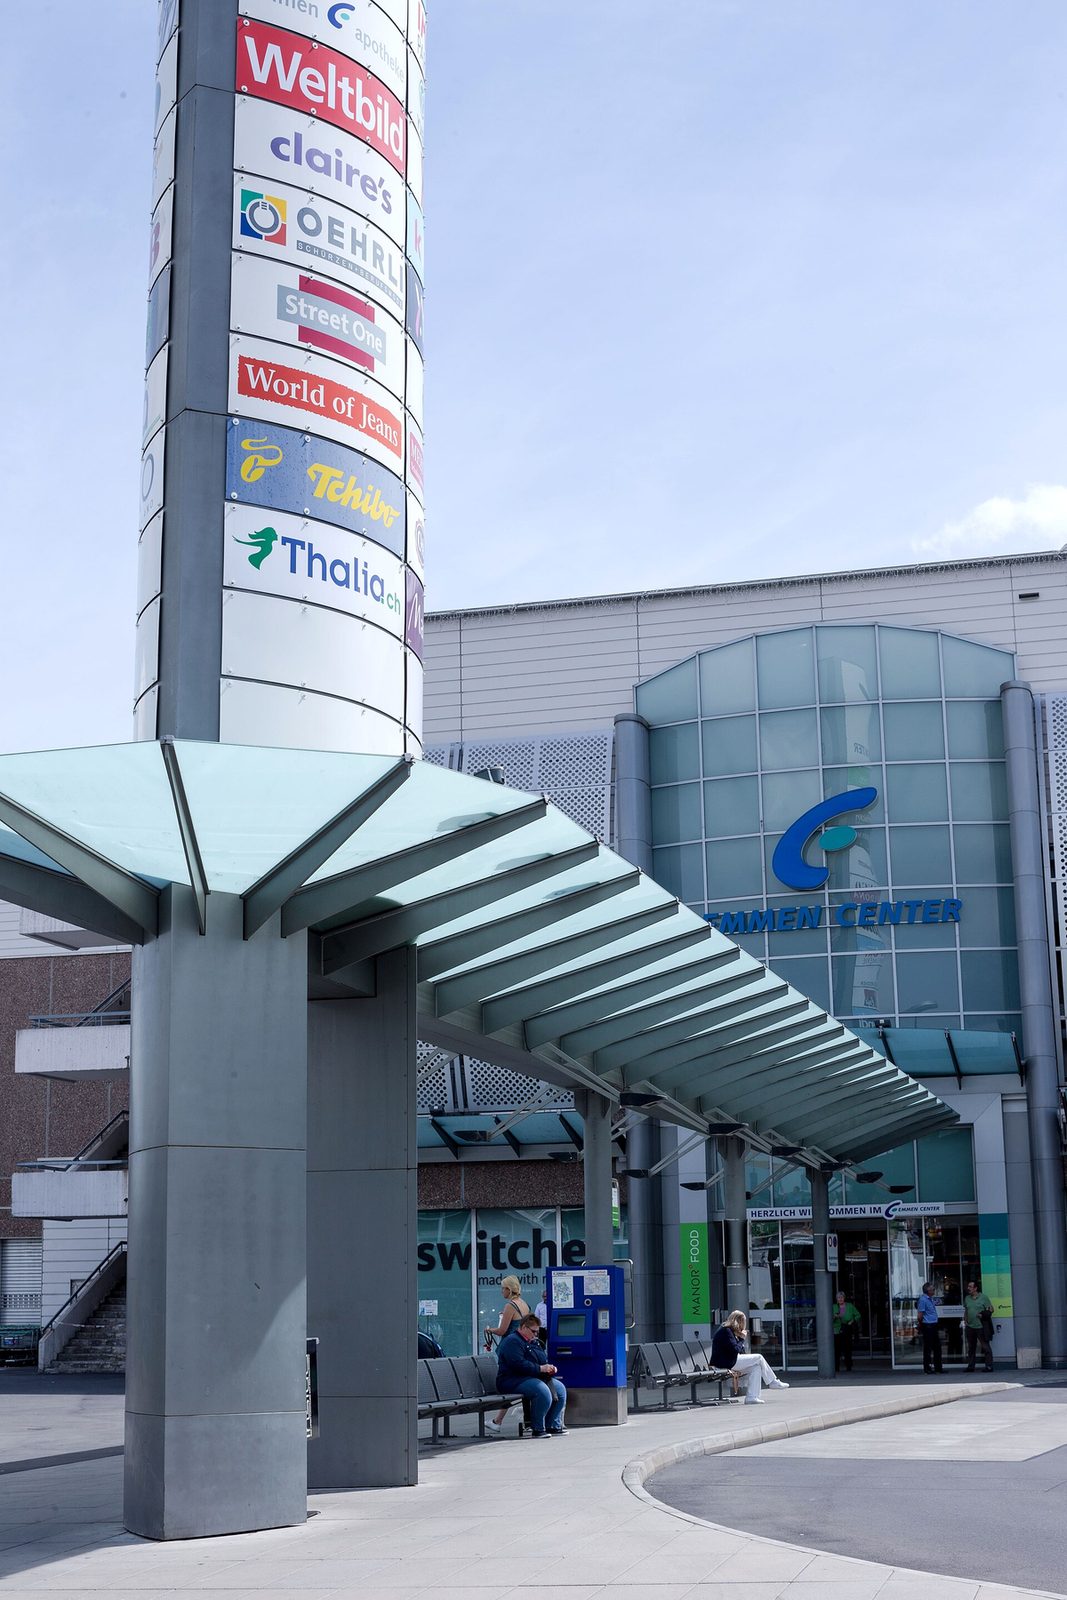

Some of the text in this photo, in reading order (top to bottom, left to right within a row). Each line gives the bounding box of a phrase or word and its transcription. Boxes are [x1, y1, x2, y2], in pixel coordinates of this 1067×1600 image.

[355, 27, 405, 83] apotheke
[244, 35, 405, 162] Weltbild
[270, 131, 393, 215] claire's
[296, 207, 404, 293] OEHRLI
[285, 294, 383, 353] Street One
[243, 363, 326, 408] World
[332, 393, 356, 418] of
[358, 404, 399, 447] Jeans
[307, 462, 400, 528] Tchibo
[835, 898, 963, 928] CENTER
[750, 1206, 882, 1218] HERZLICH WIOMMEN IM
[690, 1230, 700, 1263] FOOD
[479, 1273, 503, 1285] mad
